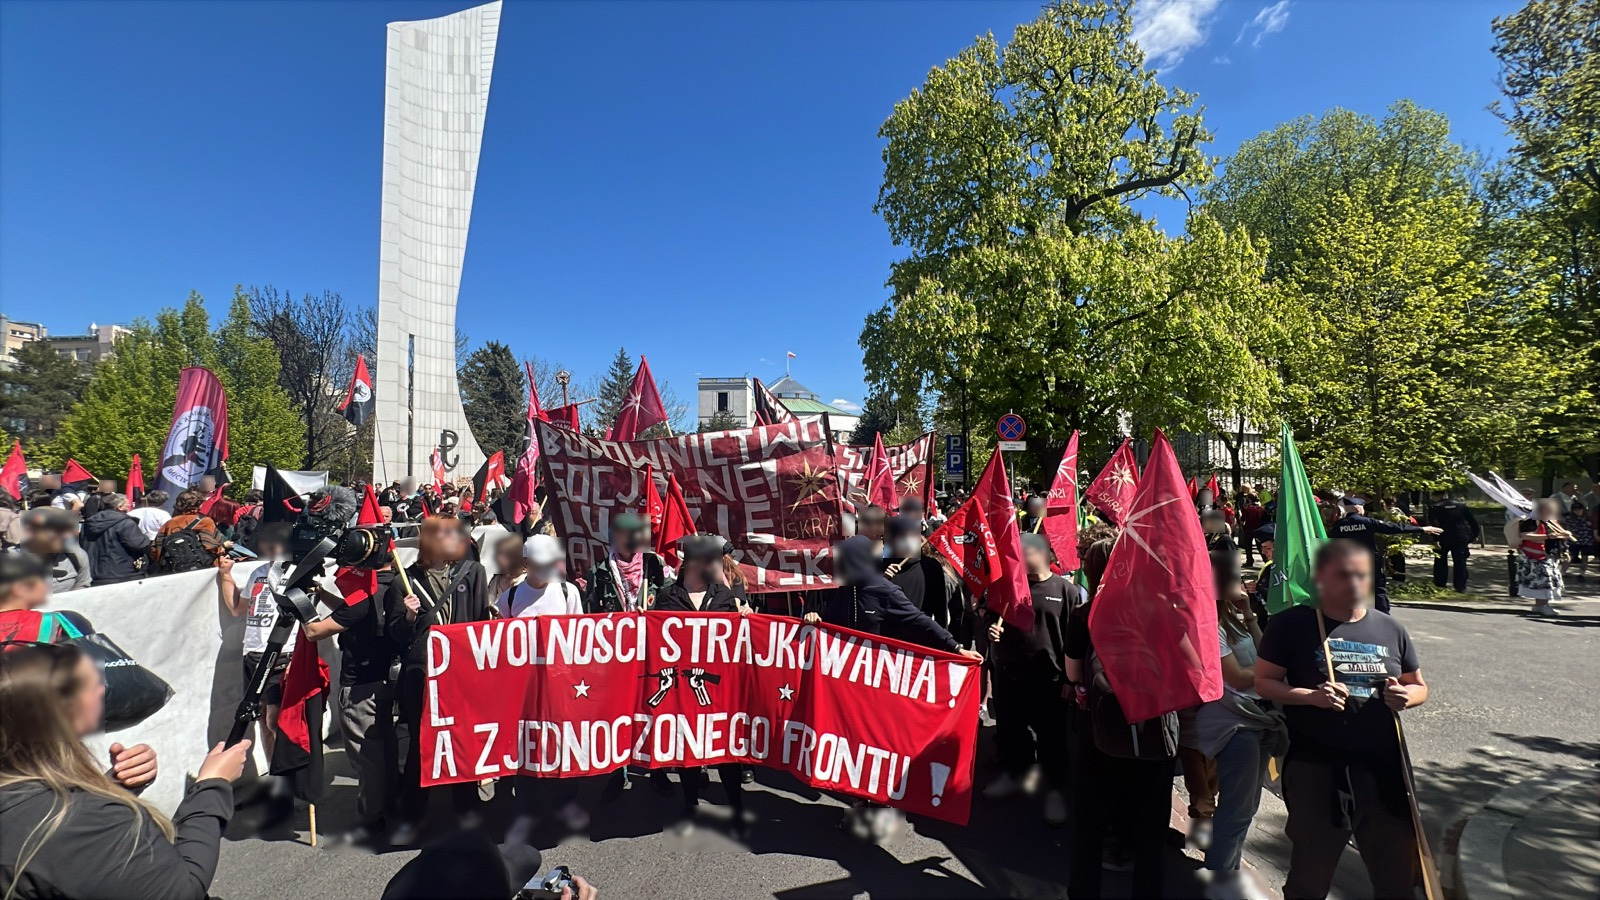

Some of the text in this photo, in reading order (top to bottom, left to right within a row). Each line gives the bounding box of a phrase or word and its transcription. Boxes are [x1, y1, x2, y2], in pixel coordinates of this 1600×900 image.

[540, 415, 827, 471] BUDOWNICTWO
[951, 437, 960, 450] P
[951, 454, 960, 468] P
[1097, 490, 1123, 514] ISKRA
[782, 515, 839, 541] ISKRA
[973, 519, 996, 557] AKCJA
[1339, 524, 1366, 533] POLICJA
[466, 612, 646, 671] WOLNOŚCI
[1348, 664, 1381, 672] MALIBU
[474, 712, 770, 776] ZJEDNOCZONEGO
